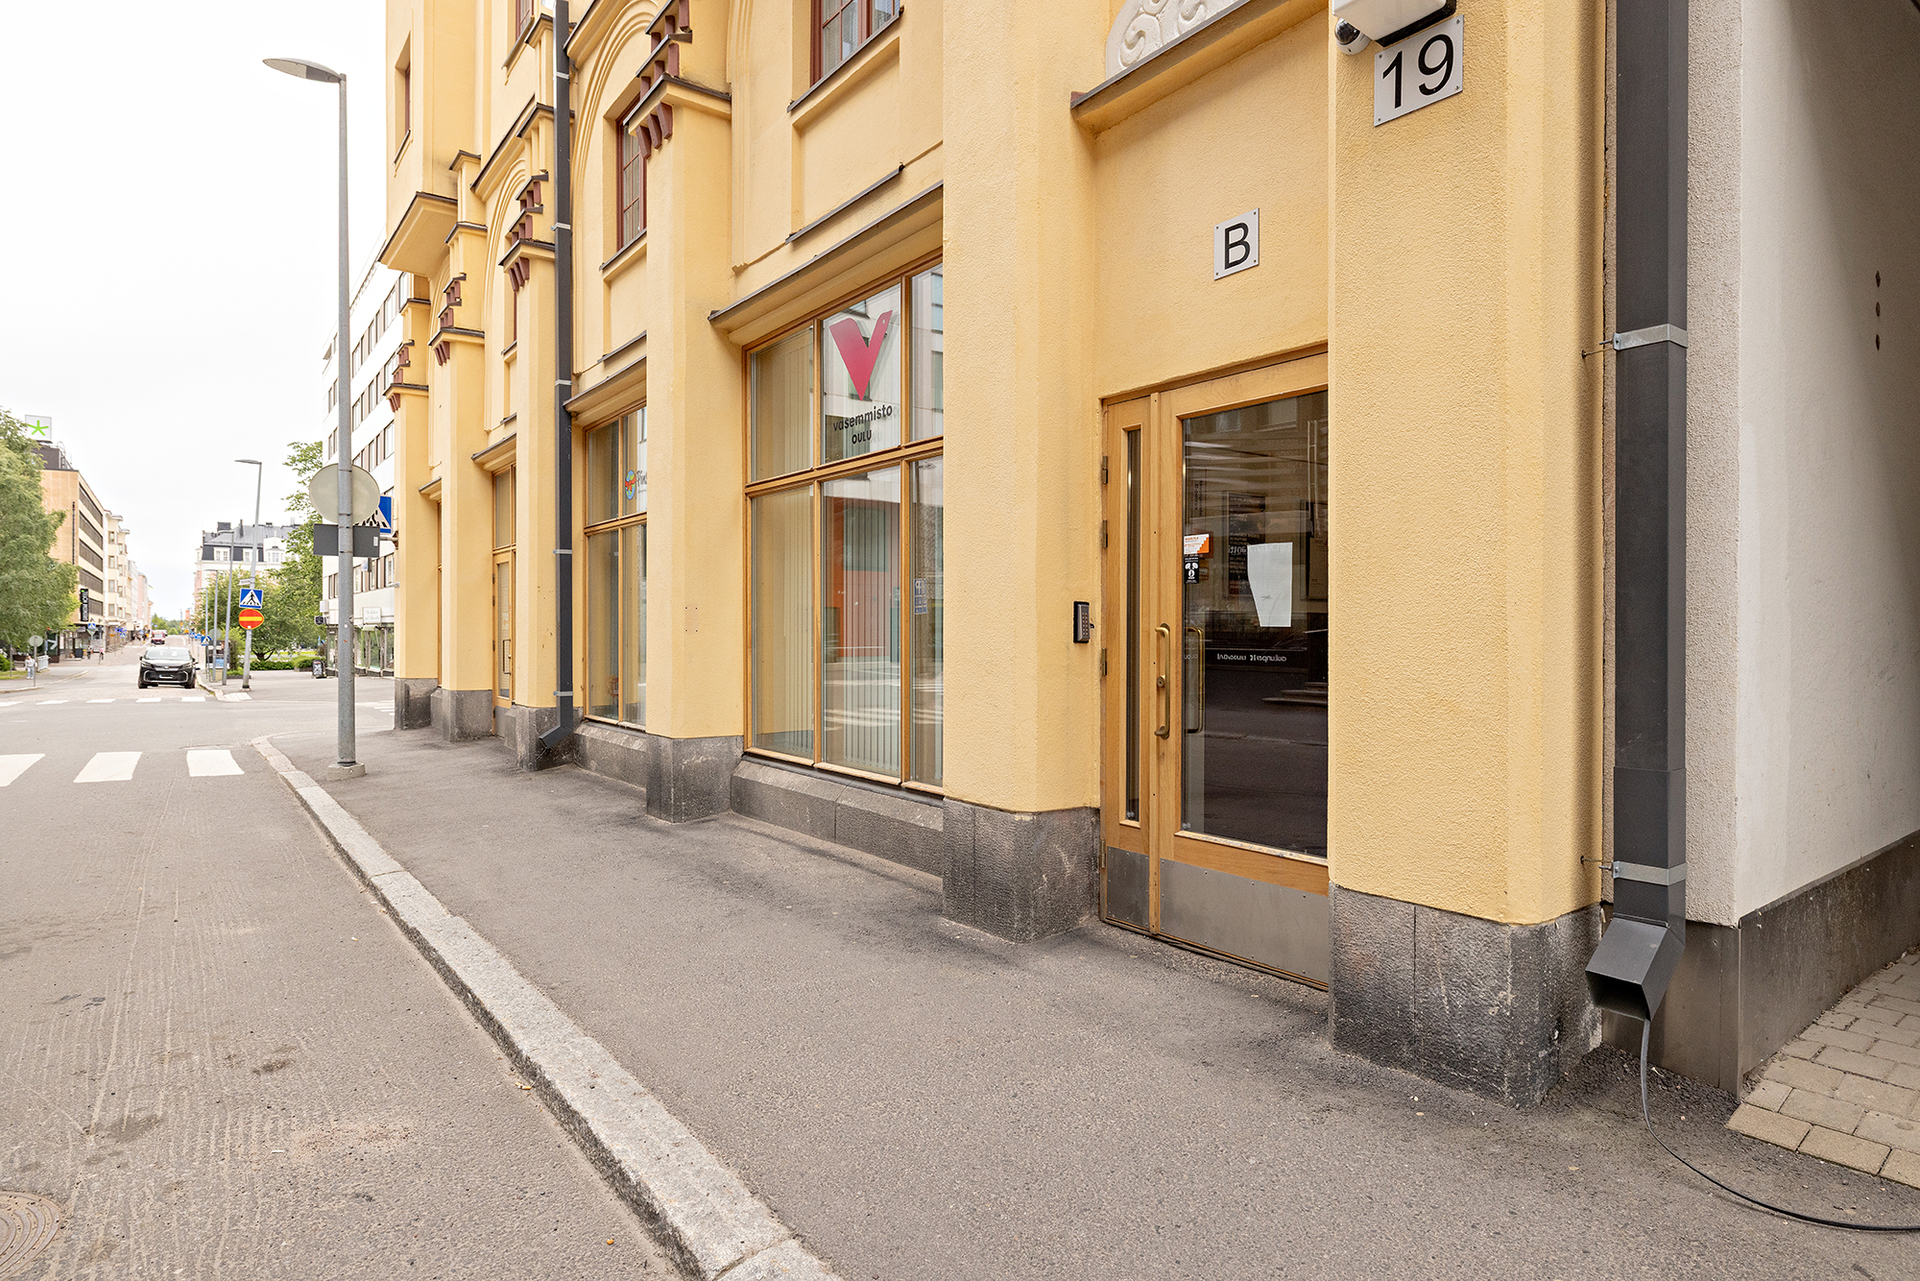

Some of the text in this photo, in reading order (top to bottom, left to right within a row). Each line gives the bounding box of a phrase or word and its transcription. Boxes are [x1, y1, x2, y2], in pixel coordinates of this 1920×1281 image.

[1382, 33, 1454, 109] 19
[1224, 222, 1251, 270] B
[833, 404, 893, 432] vasemmisto
[851, 429, 872, 445] OULU
